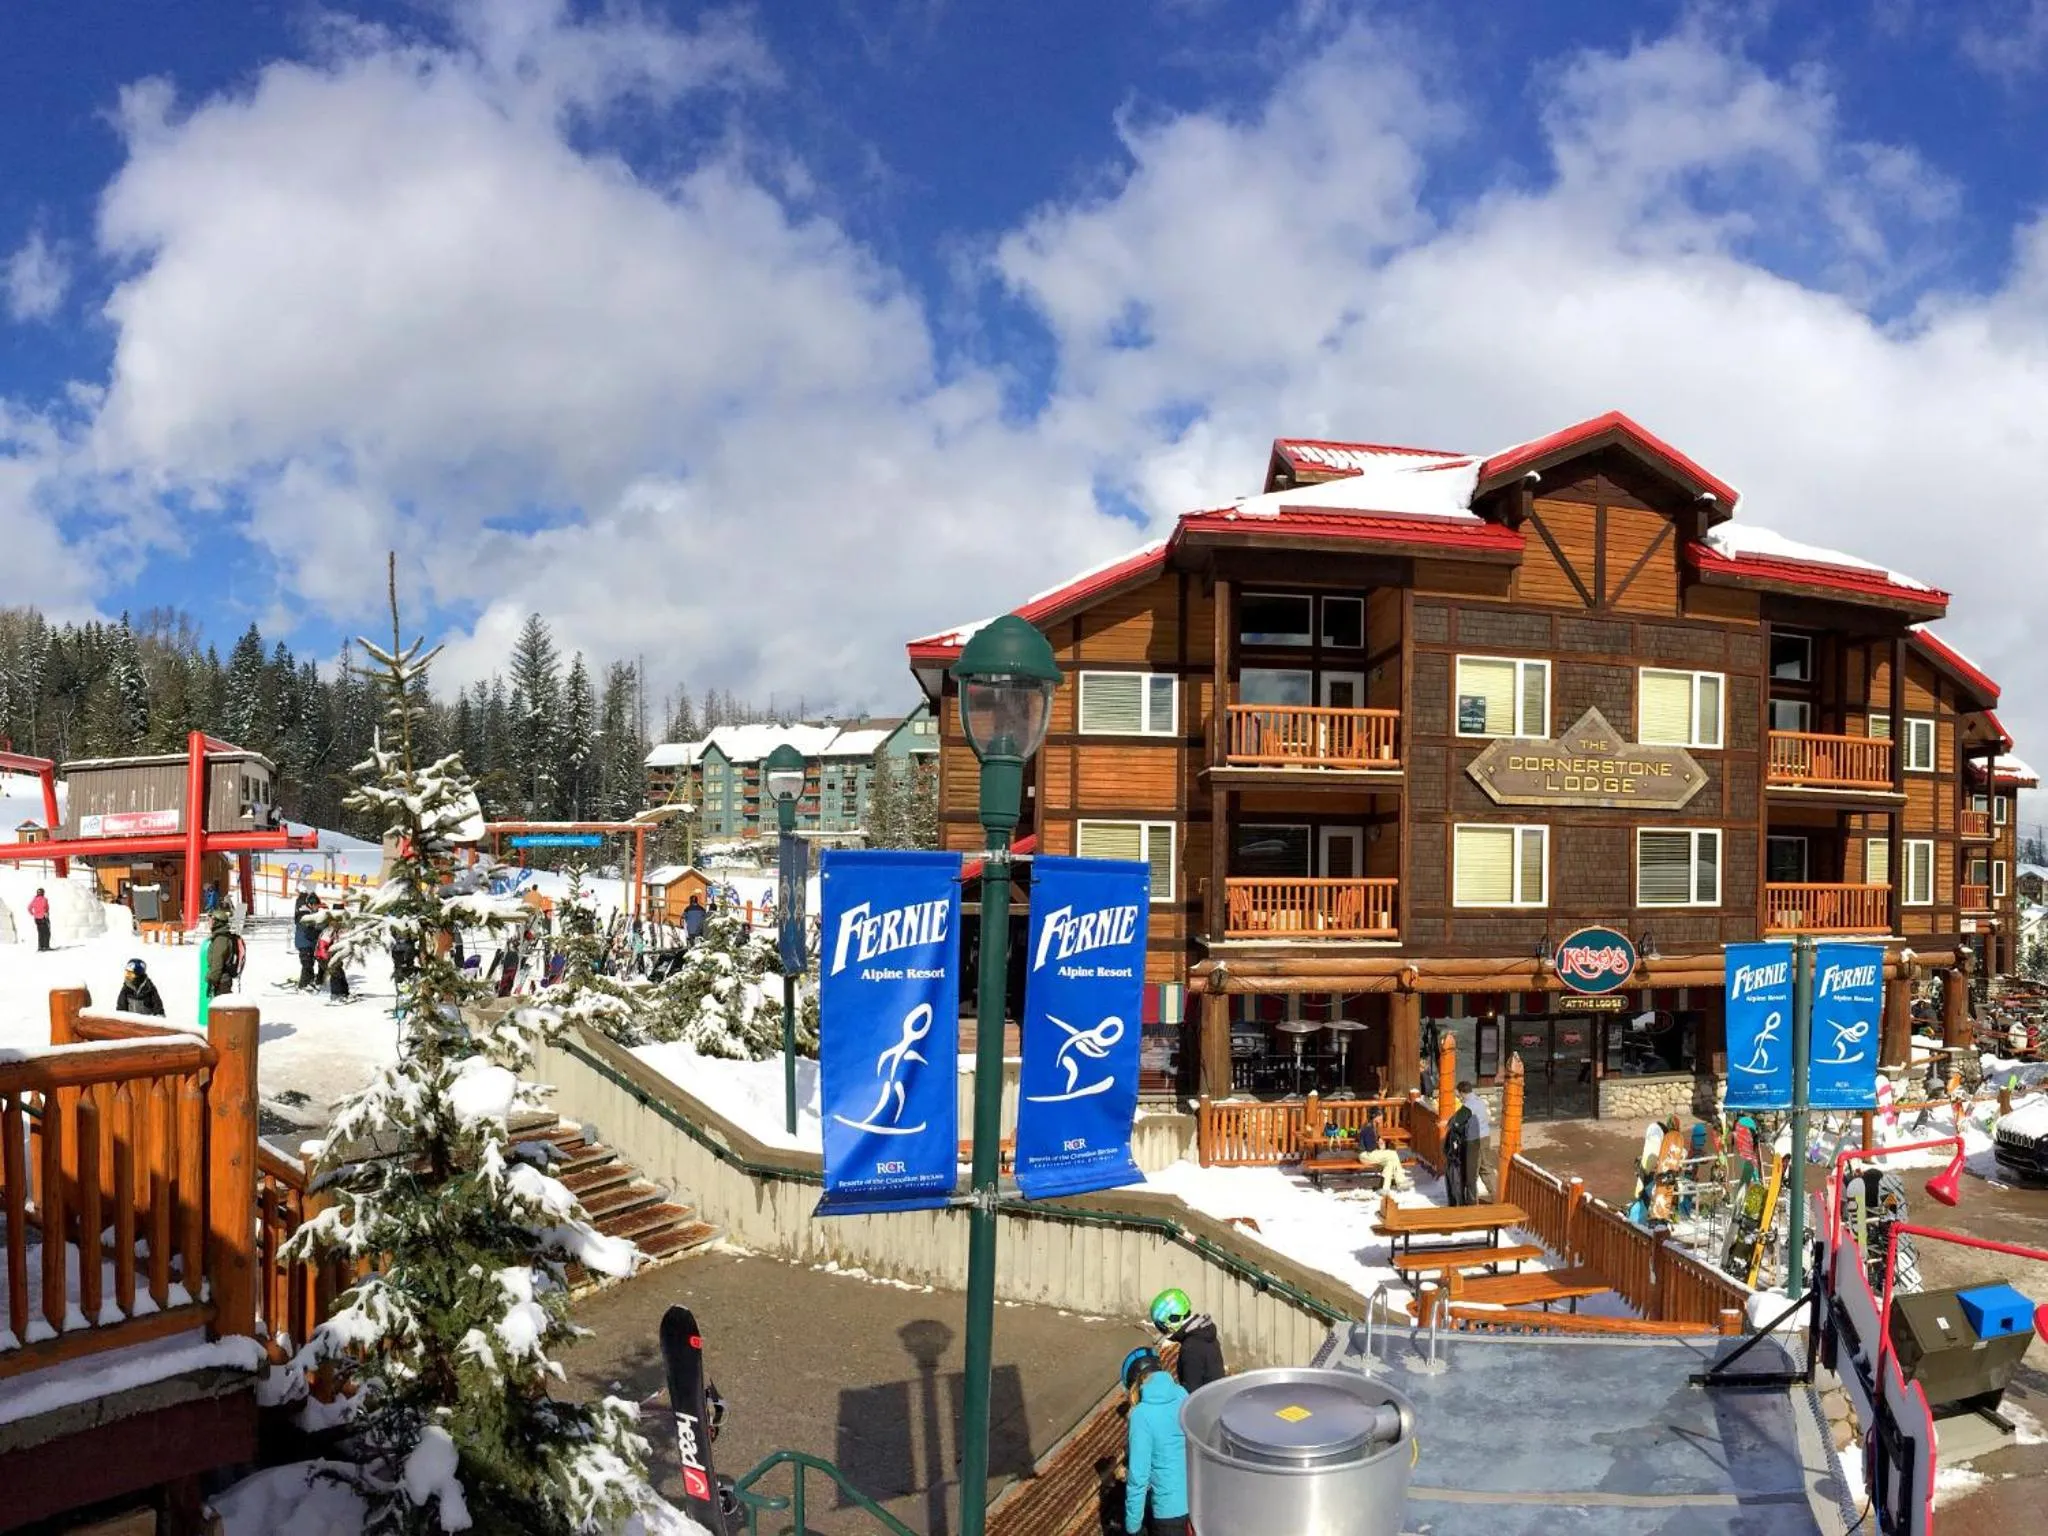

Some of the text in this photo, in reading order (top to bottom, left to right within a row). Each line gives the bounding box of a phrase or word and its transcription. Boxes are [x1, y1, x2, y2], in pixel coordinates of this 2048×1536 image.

[1579, 739, 1609, 751] THE
[1508, 756, 1673, 777] CORNERSTONE
[1546, 775, 1636, 793] LODGE
[830, 899, 950, 977] FERNIE
[1033, 904, 1138, 973] FERNIE
[1561, 945, 1630, 980] Kelsey's
[861, 966, 945, 981] Alpine Resort
[1057, 966, 1133, 979] Alpine Resort
[1731, 962, 1788, 1001] FERNIE
[1819, 963, 1877, 998] FERNIE
[1566, 1000, 1577, 1008] AT
[1578, 1000, 1594, 1008] THE
[1064, 1138, 1087, 1151] RCR
[876, 1161, 906, 1175] RCR
[675, 1411, 706, 1472] head
